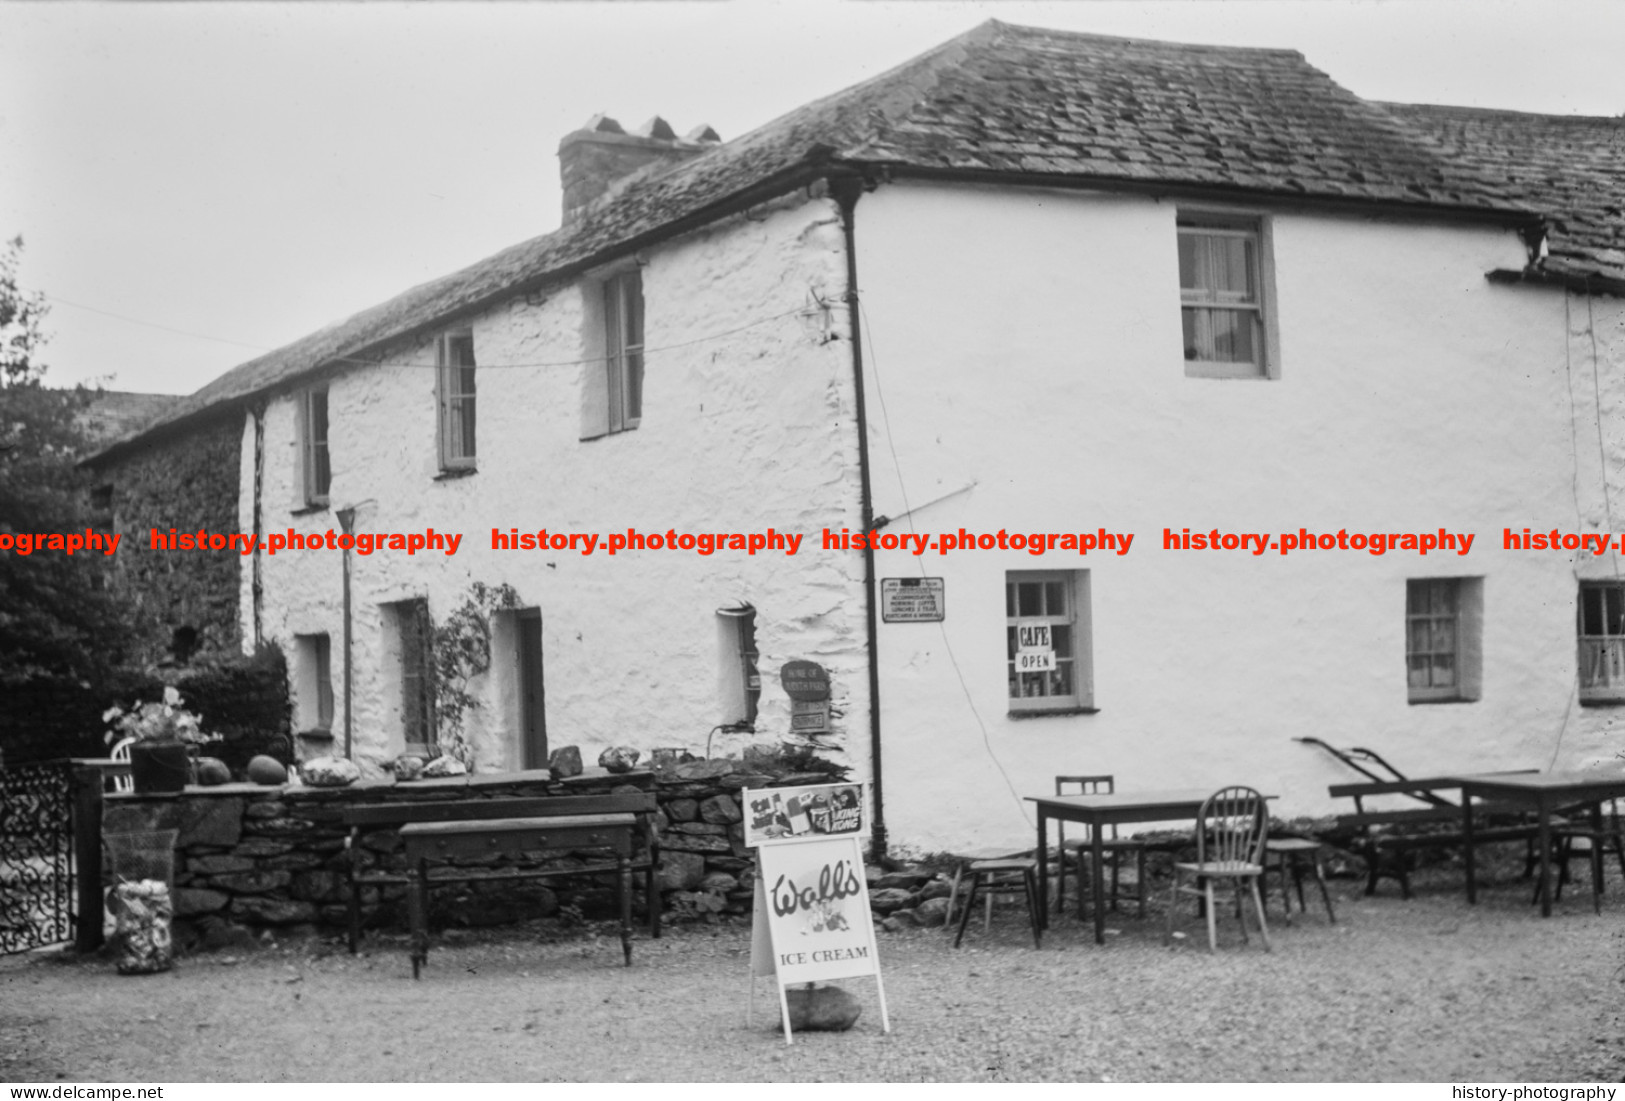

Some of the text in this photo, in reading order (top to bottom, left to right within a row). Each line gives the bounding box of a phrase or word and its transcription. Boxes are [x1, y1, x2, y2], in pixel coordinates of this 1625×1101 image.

[1020, 626, 1049, 647] CAFE
[1022, 655, 1049, 668] OPEN
[808, 668, 817, 678] OF
[834, 807, 861, 821] KING
[832, 818, 859, 832] KONG
[770, 859, 860, 918] Wall's
[780, 946, 868, 966] ICE CREAM
